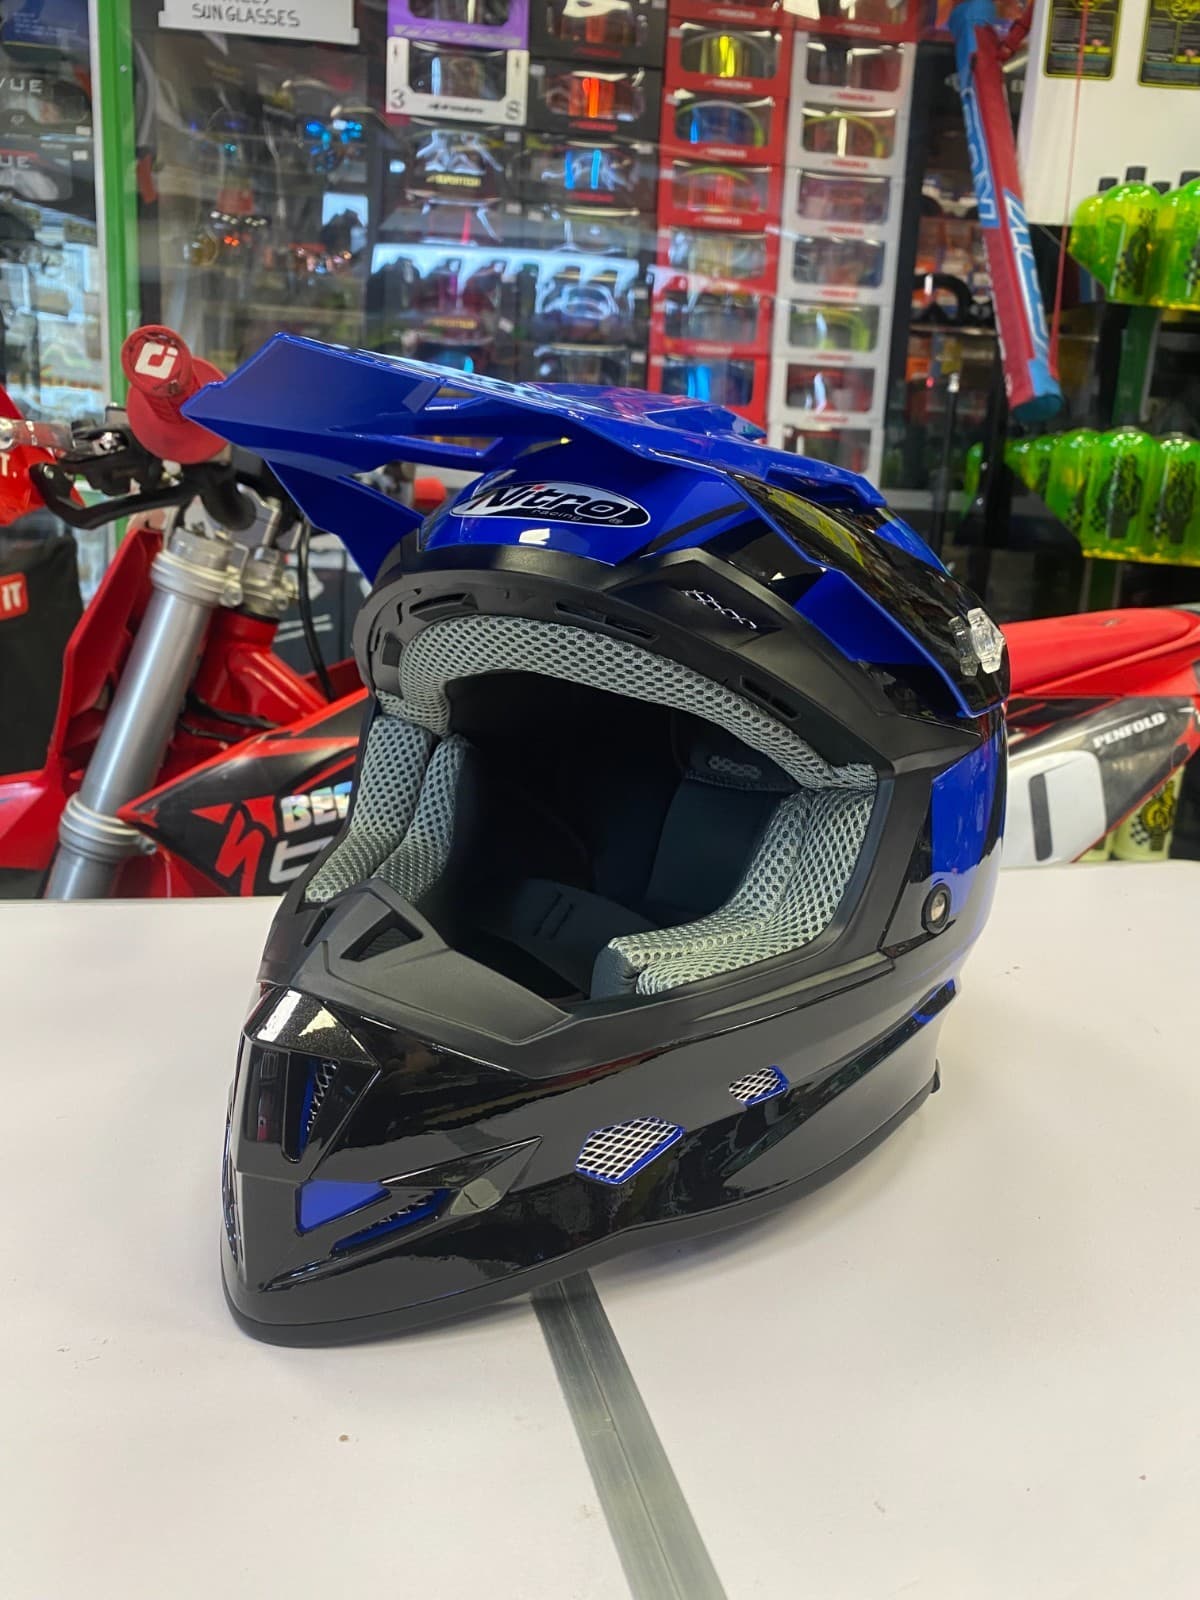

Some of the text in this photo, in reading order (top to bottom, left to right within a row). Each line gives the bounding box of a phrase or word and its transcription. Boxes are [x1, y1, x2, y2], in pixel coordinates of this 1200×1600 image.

[191, 3, 300, 28] SUNGLASSES
[463, 484, 633, 520] Nitro
[532, 509, 583, 521] racing
[1092, 711, 1167, 749] PENFOLD
